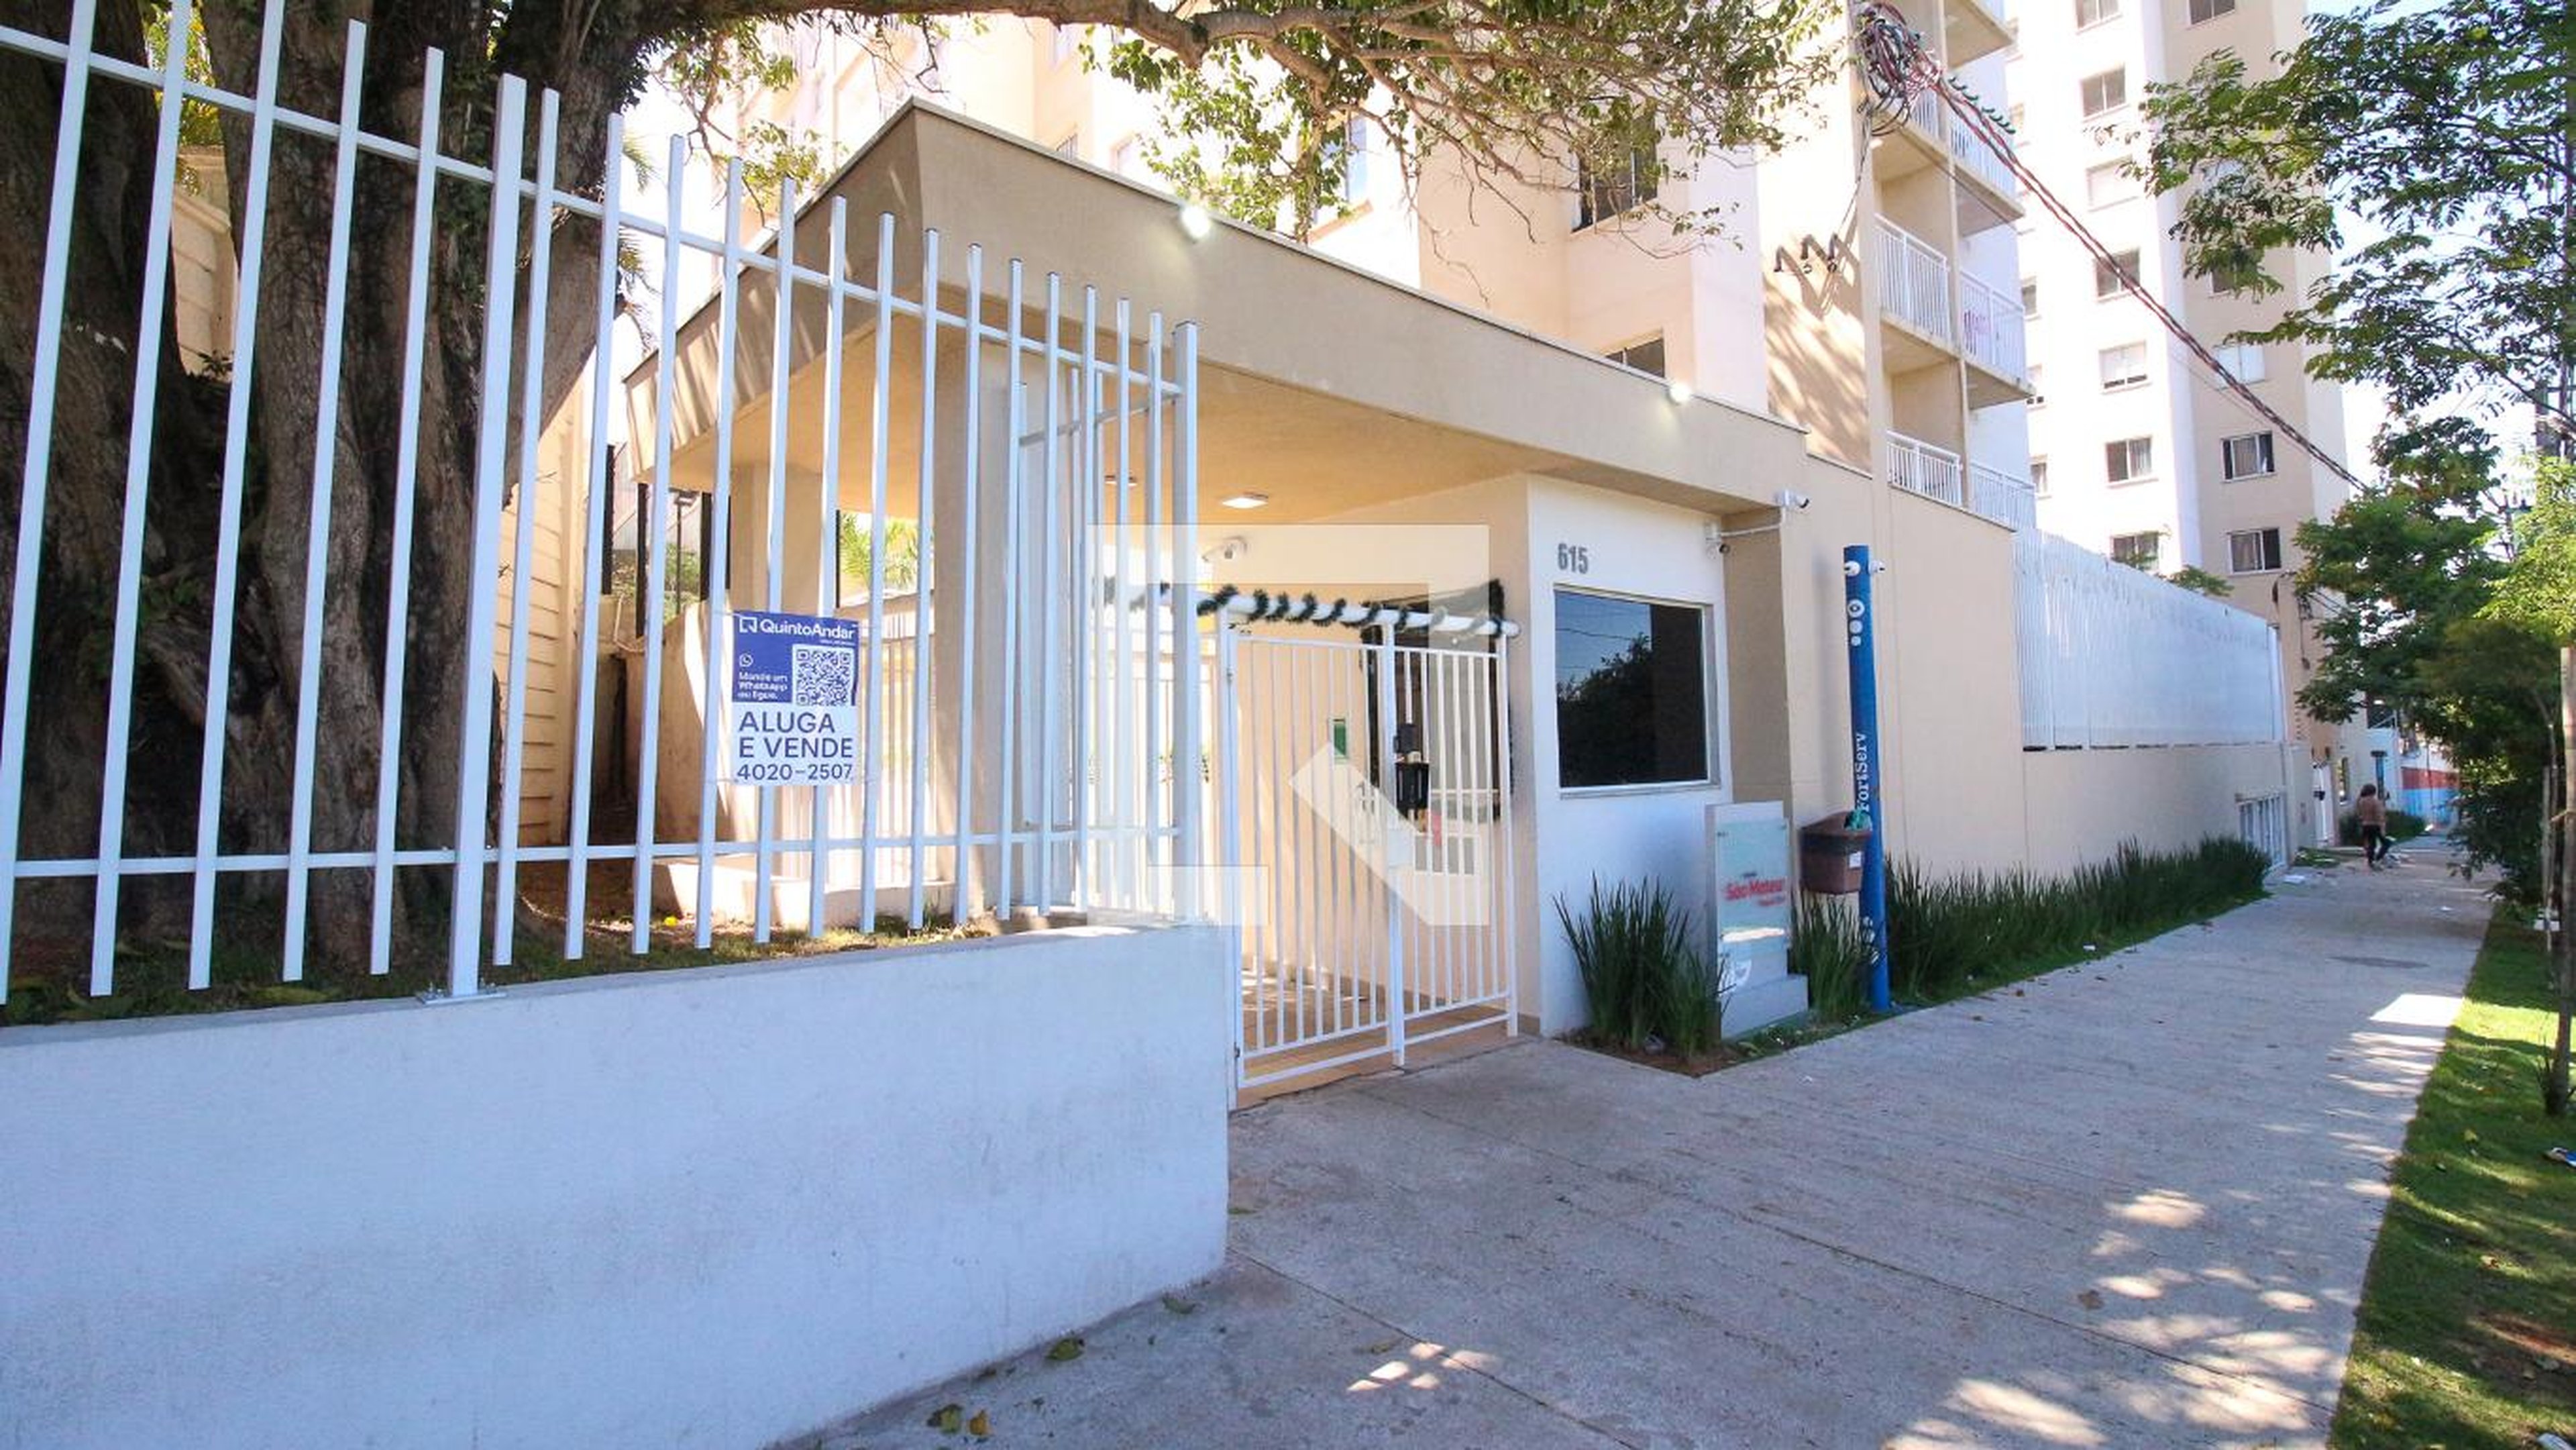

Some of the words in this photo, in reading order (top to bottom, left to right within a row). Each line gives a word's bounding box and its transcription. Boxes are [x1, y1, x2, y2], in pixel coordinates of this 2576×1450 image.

[1558, 543, 1589, 574] 615
[760, 619, 855, 639] QuintoAndar
[739, 711, 835, 733] ALUGA
[740, 737, 755, 758] E
[763, 737, 853, 758] VENDE
[737, 764, 853, 780] 4020-2507
